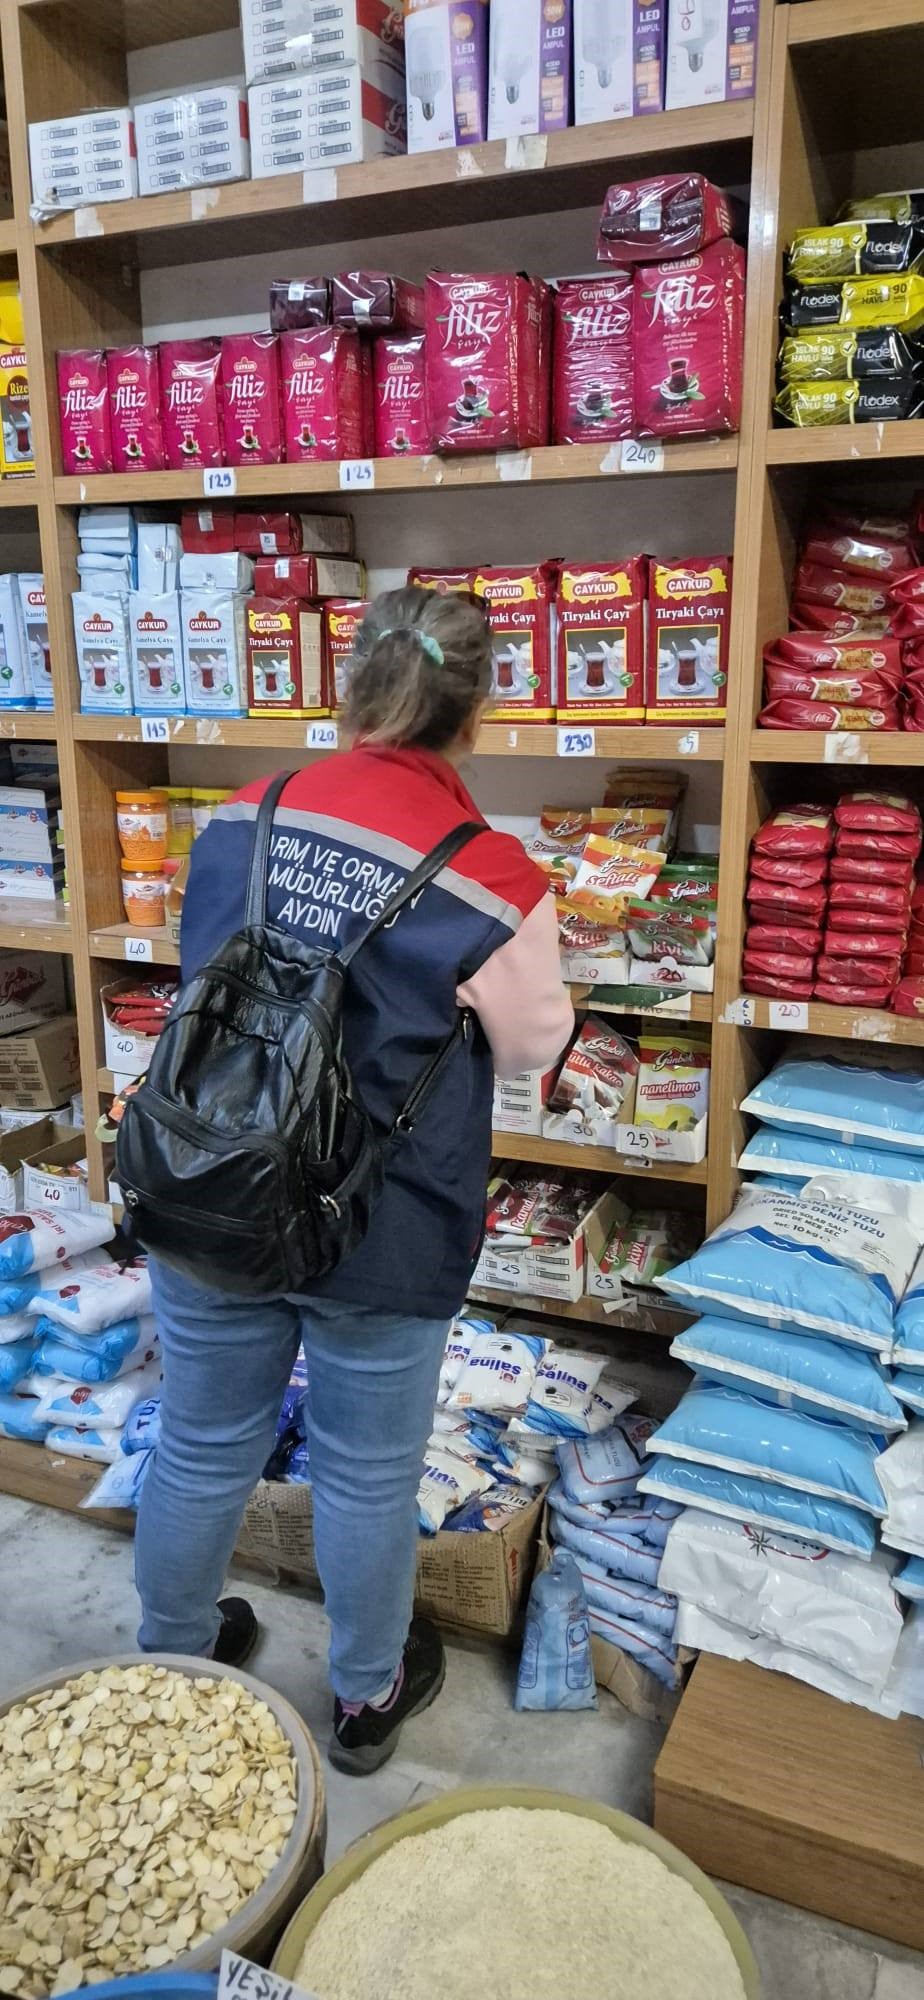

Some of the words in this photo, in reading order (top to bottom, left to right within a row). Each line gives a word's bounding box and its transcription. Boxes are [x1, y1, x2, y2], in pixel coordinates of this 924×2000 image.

[640, 9, 660, 22] LED
[546, 26, 566, 39] LED
[456, 43, 475, 55] LED
[893, 284, 908, 294] 90
[442, 302, 502, 349] filiz
[568, 304, 628, 347] filiz
[822, 345, 835, 355] 90
[857, 347, 891, 359] flode
[10, 382, 29, 396] Rize
[229, 375, 265, 406] filiz
[288, 371, 325, 402] filiz
[380, 375, 421, 406] filiz
[64, 389, 96, 418] filiz
[114, 386, 147, 415] filiz
[169, 381, 204, 412] filiz
[823, 393, 837, 403] 90
[626, 448, 656, 463] 240
[208, 474, 231, 489] 125
[489, 612, 509, 625] yaki
[511, 611, 536, 624] Çayı
[563, 610, 602, 623] Tiryaki
[604, 609, 630, 622] Çayı
[656, 607, 695, 620] Tiryaki
[697, 605, 724, 618] Çayı
[311, 729, 335, 742] 120
[564, 734, 593, 752] 230
[269, 834, 311, 864] RIM
[313, 845, 343, 872] VE
[277, 897, 342, 937] AYDIN
[129, 942, 146, 956] 40
[577, 967, 599, 979] 20
[778, 1004, 800, 1018] 20
[117, 1041, 133, 1052] 40
[592, 1061, 624, 1088] kakao
[641, 1080, 700, 1096] nanelimon
[571, 1122, 593, 1137] 30
[626, 1131, 649, 1148] 25
[44, 1188, 60, 1201] 40
[811, 1205, 849, 1224] DENİZ
[852, 1220, 886, 1239] TUZU
[847, 1209, 880, 1226] TUZU
[793, 1224, 805, 1233] 10
[501, 1264, 520, 1275] 25
[594, 1274, 614, 1289] 25
[448, 1344, 471, 1356] sal
[470, 1357, 522, 1376] salina
[536, 1368, 588, 1393] salina
[425, 1465, 459, 1489] lina
